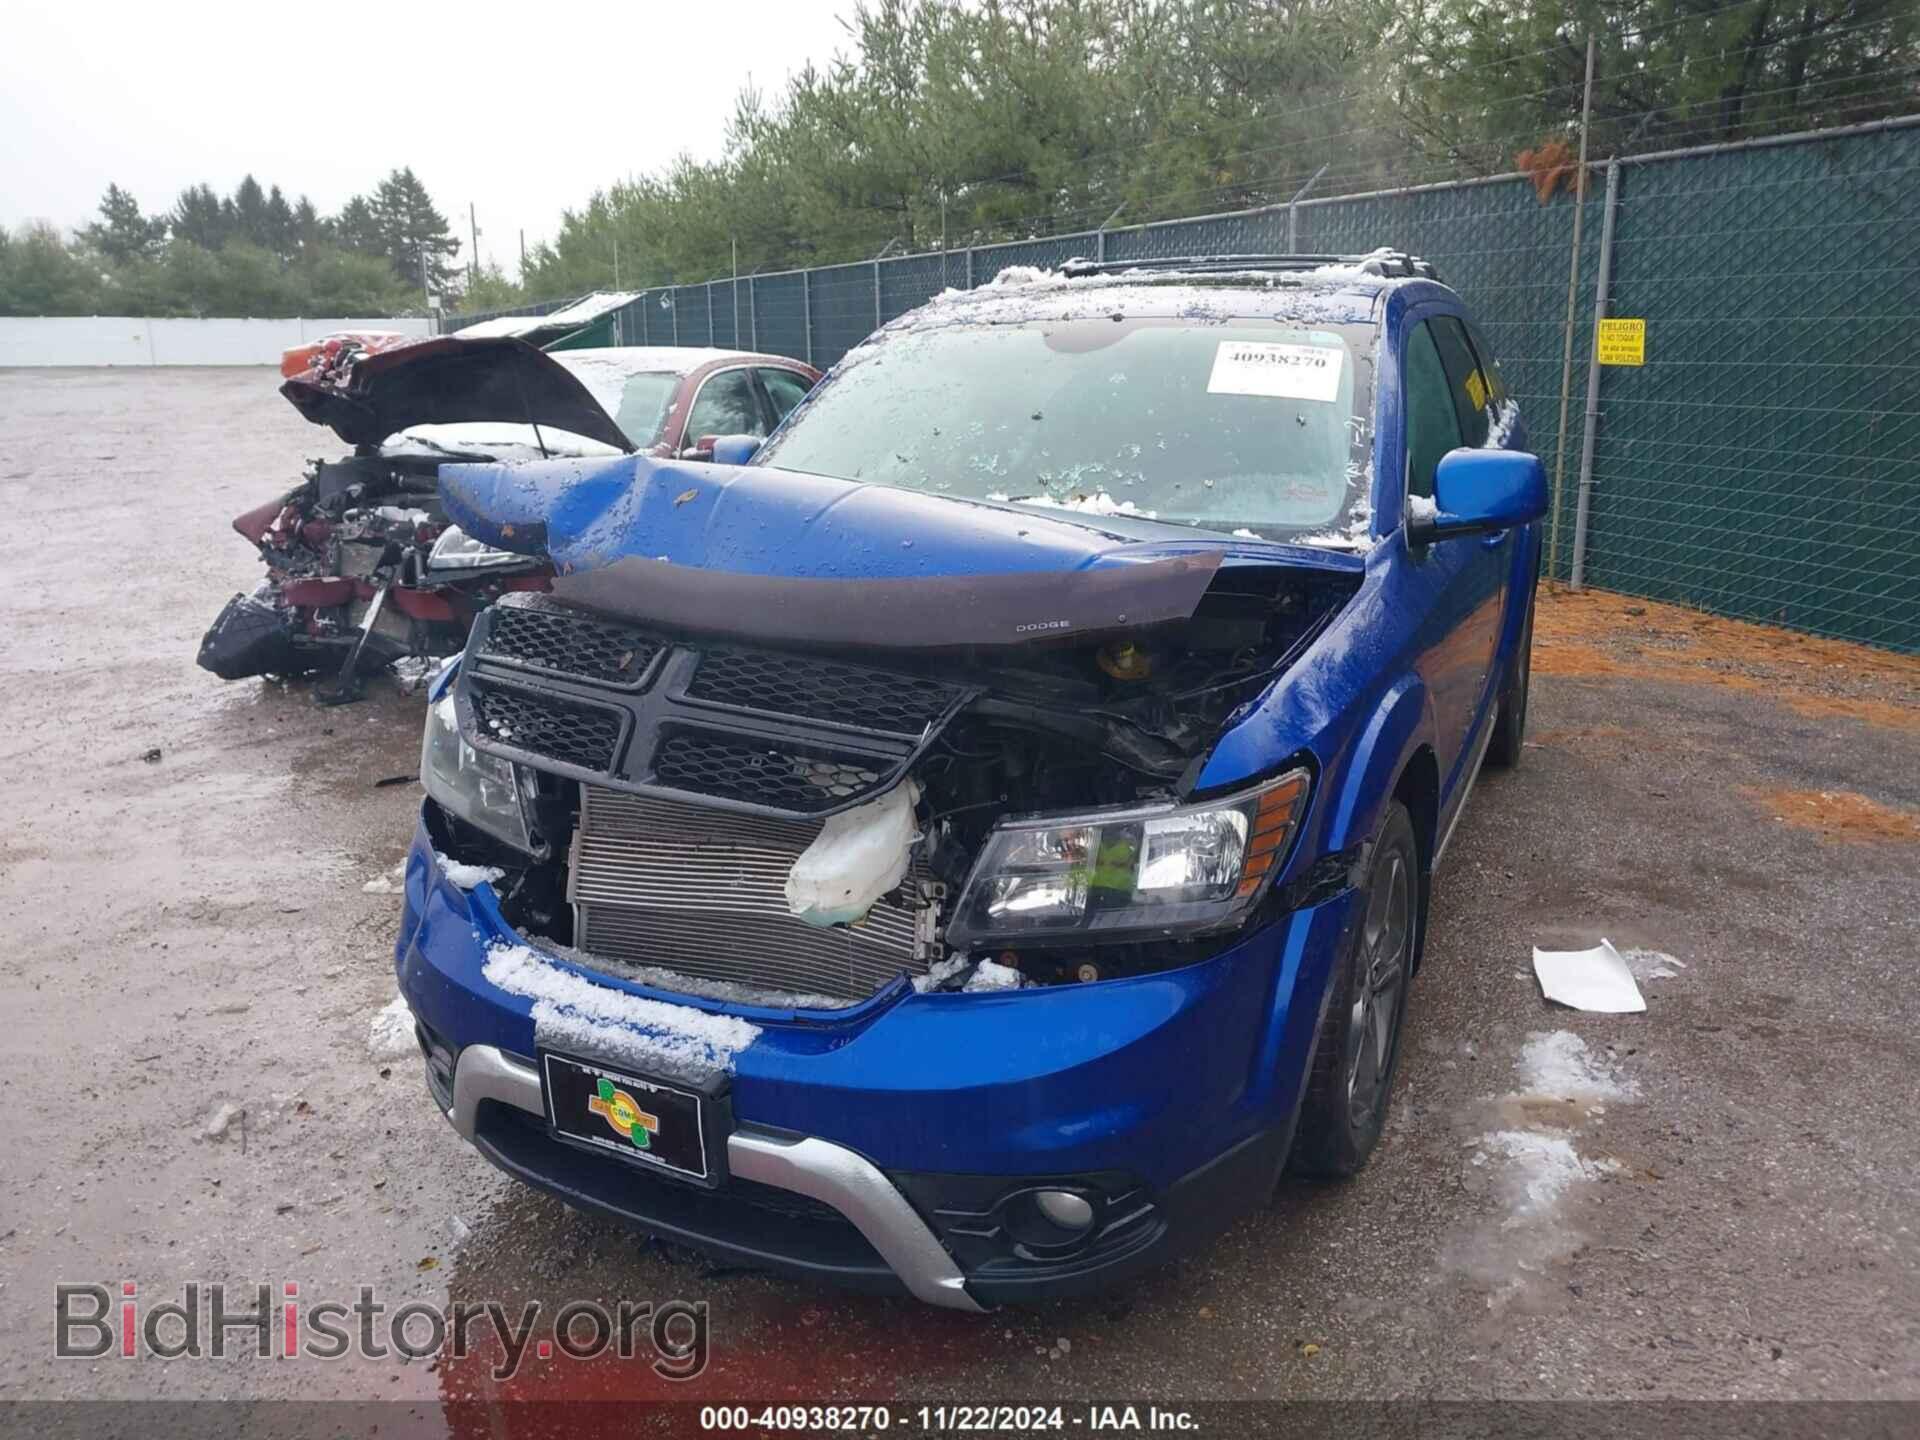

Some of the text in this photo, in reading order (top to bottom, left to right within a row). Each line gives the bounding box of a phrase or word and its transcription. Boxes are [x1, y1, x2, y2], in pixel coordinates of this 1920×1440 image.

[1602, 322, 1643, 331] PELIGRO
[1228, 352, 1327, 369] 40938270
[1016, 620, 1070, 633] DODGE
